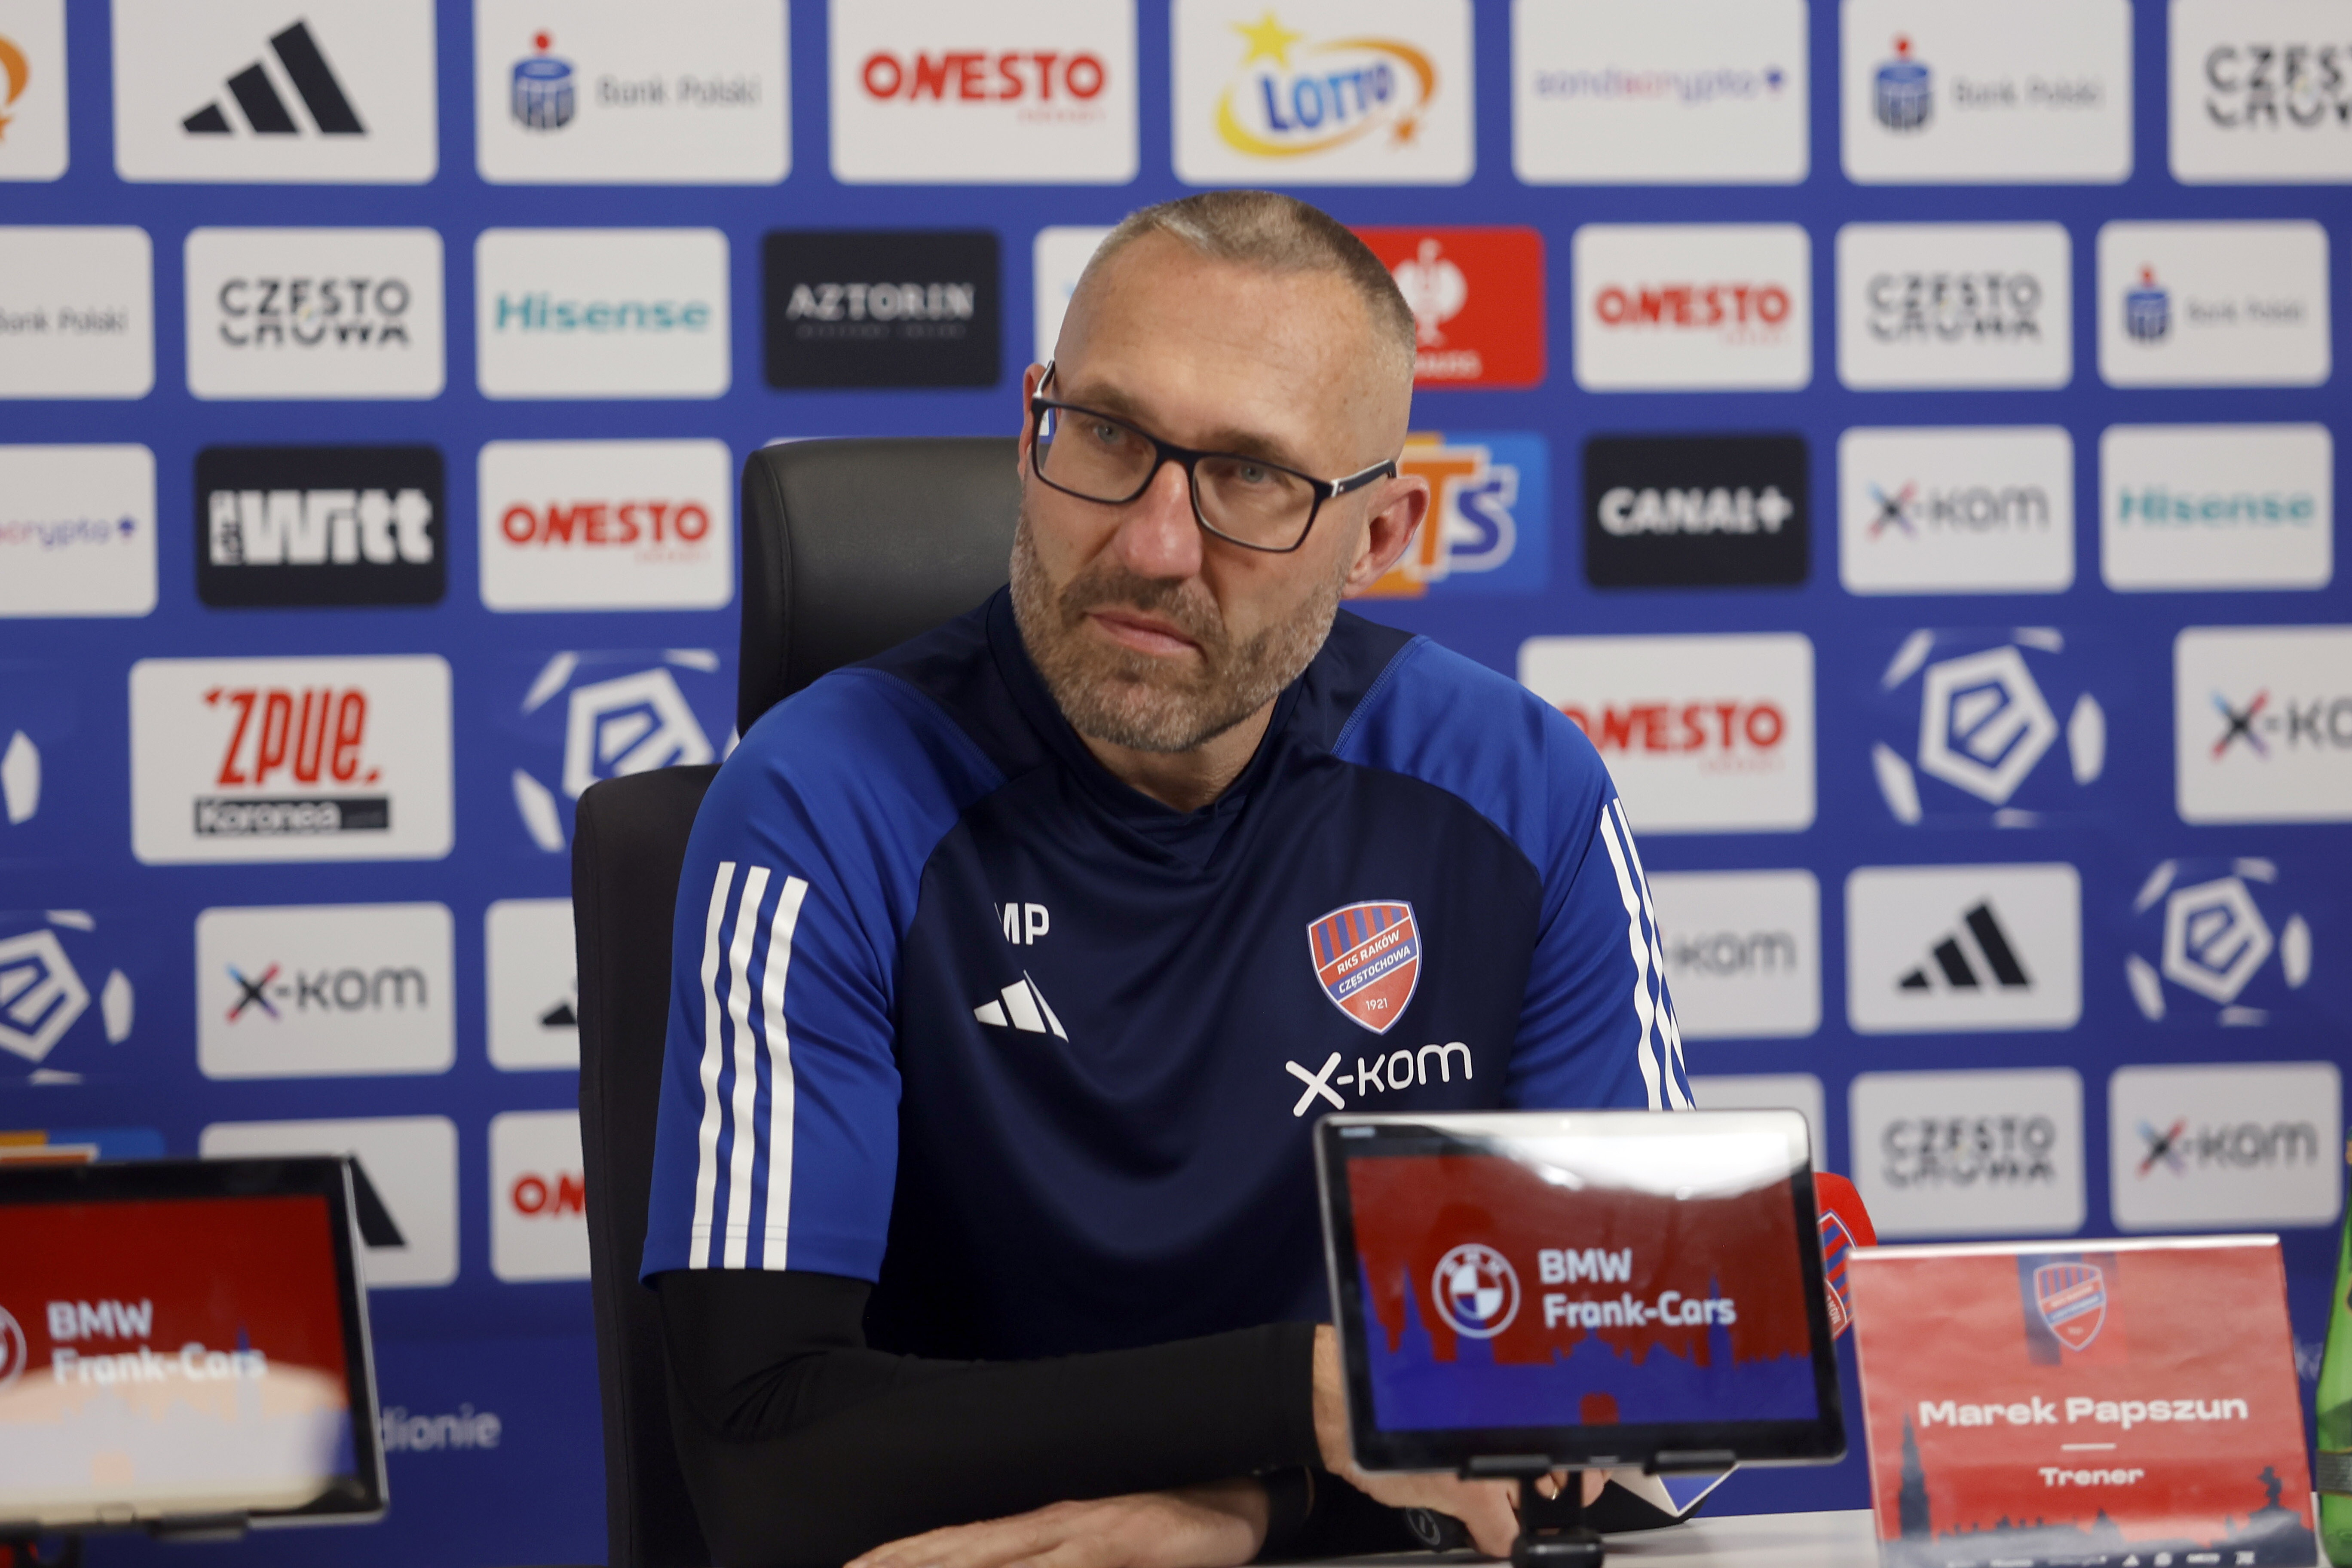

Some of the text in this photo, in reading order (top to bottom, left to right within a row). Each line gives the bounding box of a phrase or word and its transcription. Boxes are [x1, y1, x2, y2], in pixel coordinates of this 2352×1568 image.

[595, 75, 667, 107] Bank
[860, 51, 1107, 102] ONESTO
[1951, 78, 2019, 109] Bank
[494, 293, 710, 331] Hisense
[788, 284, 974, 320] AZTORIN
[1595, 285, 1791, 327] ONESTO
[500, 502, 710, 546] ONESTO
[1397, 447, 1516, 576] TS
[1599, 487, 1792, 535] CANAL+
[2118, 489, 2316, 526] Hisense
[1337, 929, 1400, 975] RKS RAKÓW
[1338, 945, 1411, 994] CZĘSTOCHOWA
[1365, 997, 1388, 1011] 1921
[1538, 1248, 1632, 1284] BMW
[47, 1300, 153, 1340] BMW
[1543, 1289, 1736, 1329] Frank-Cars
[51, 1344, 266, 1385] Frank-Cars
[1918, 1396, 2248, 1430] Marek Papszun
[2039, 1467, 2144, 1486] Trener
